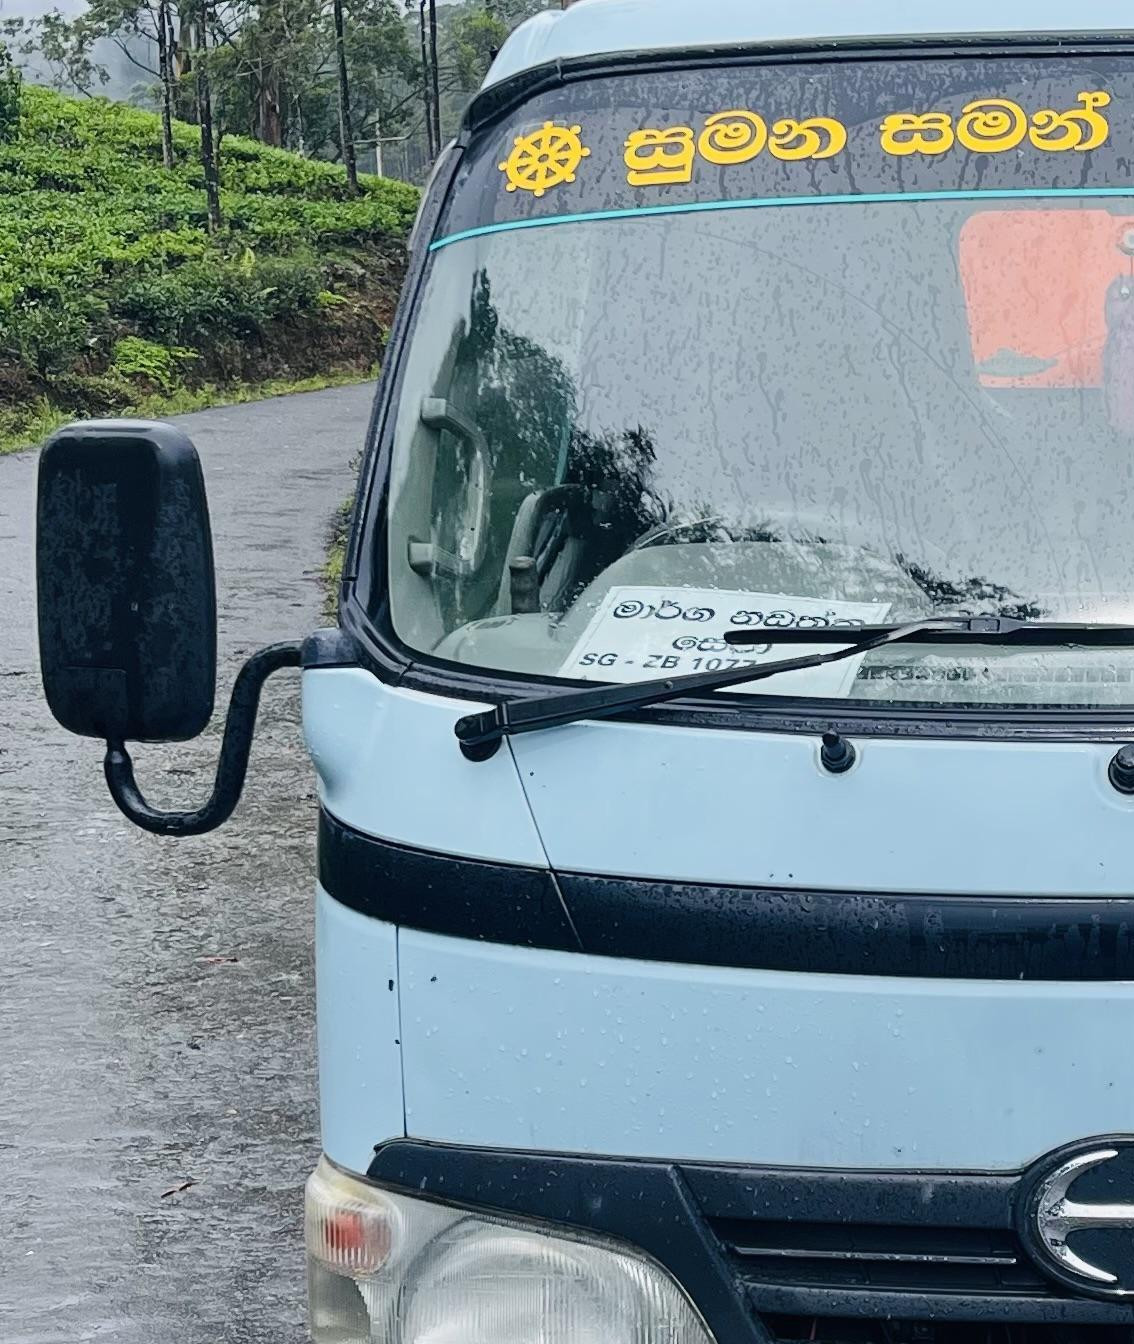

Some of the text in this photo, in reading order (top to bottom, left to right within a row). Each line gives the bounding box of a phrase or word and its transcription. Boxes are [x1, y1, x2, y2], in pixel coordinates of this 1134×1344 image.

[623, 110, 848, 186] සුමන
[879, 90, 1111, 156] සමන්
[578, 652, 619, 667] SG
[642, 654, 681, 670] ZB
